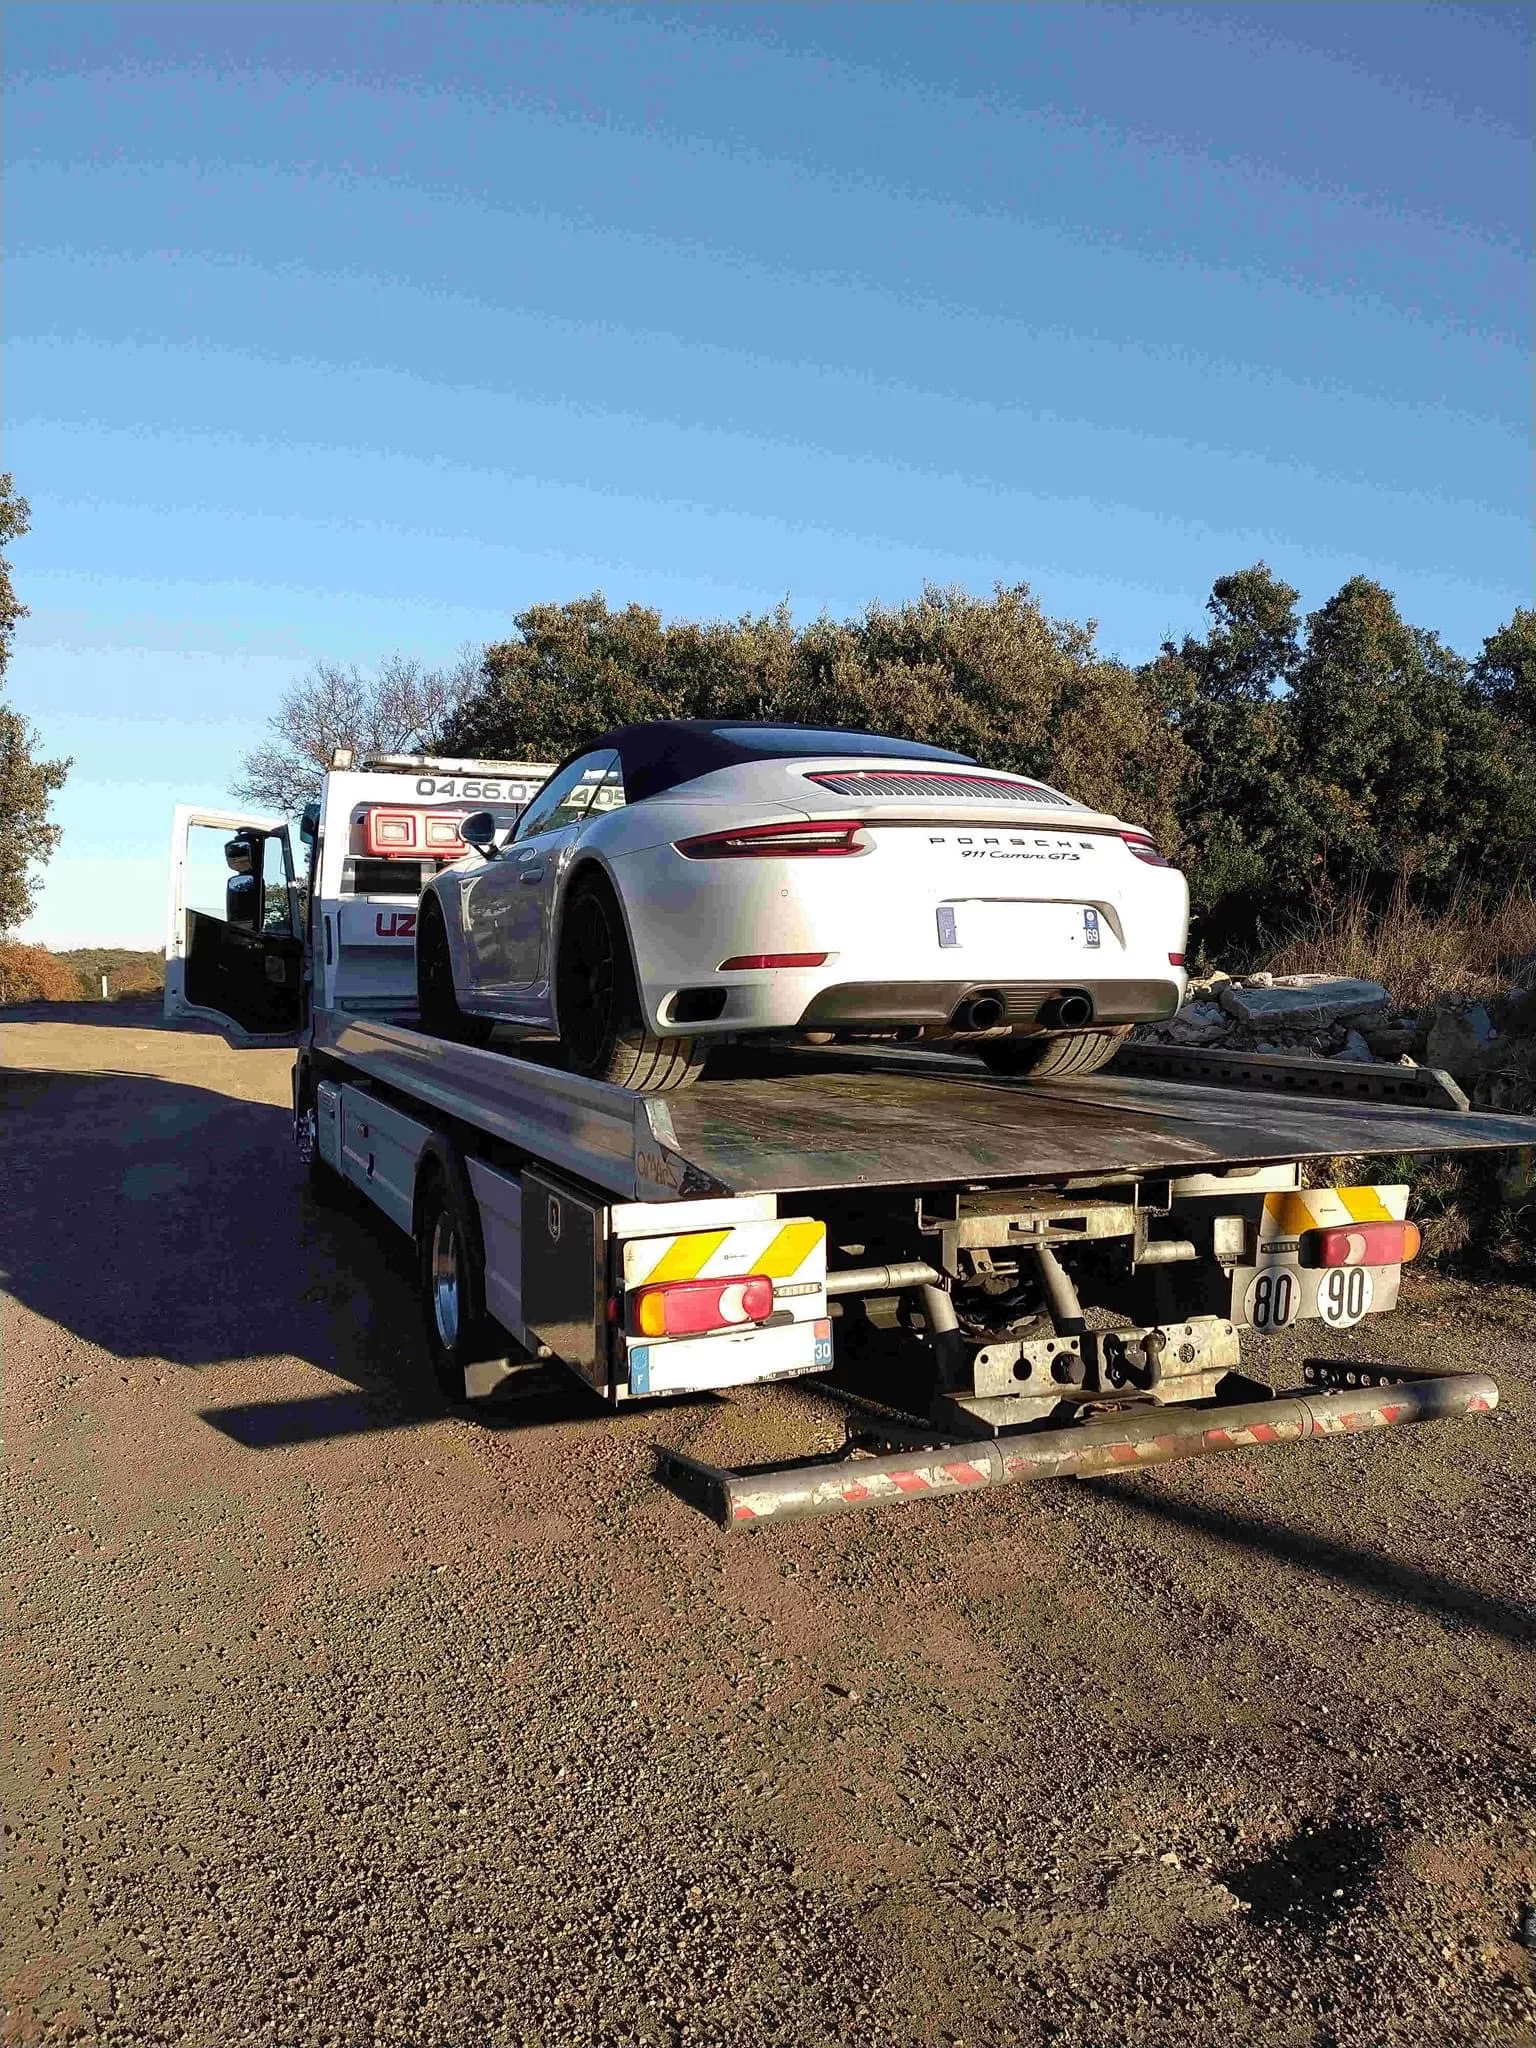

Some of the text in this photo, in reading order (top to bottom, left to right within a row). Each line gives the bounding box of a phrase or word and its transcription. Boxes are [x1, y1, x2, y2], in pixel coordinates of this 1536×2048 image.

[929, 837, 1095, 850] PORSCHE
[961, 850, 1081, 861] 911 Carrera GTS
[945, 928, 951, 939] F
[1086, 928, 1099, 942] 69
[1327, 1267, 1365, 1321] 90
[1253, 1274, 1292, 1328] 80
[815, 1342, 831, 1360] 30
[637, 1374, 643, 1386] F
